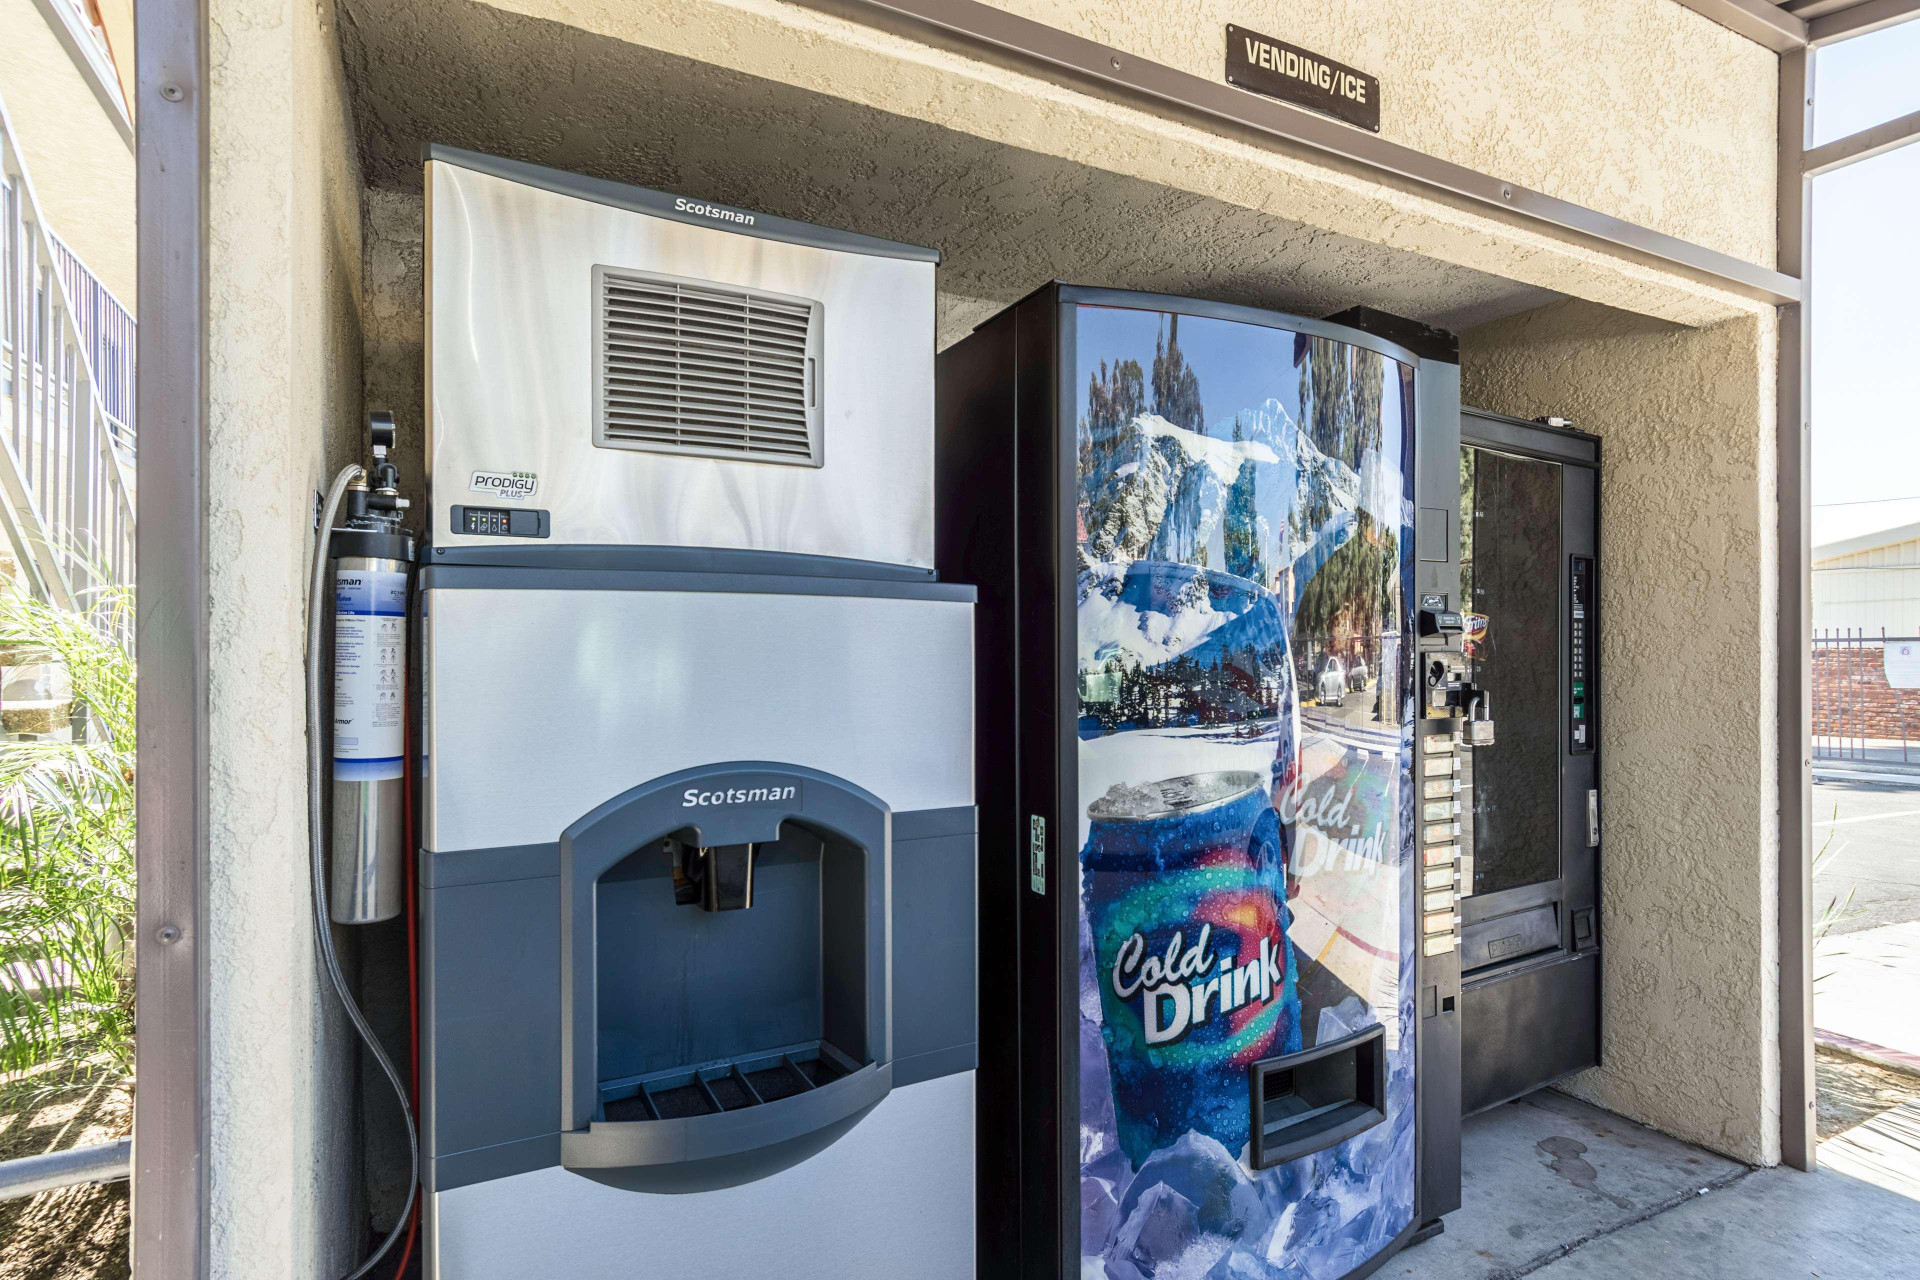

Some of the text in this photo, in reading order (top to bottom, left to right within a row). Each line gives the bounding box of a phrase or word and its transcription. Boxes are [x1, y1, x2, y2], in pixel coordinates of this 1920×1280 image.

[1245, 37, 1366, 104] VENDING/ICE
[674, 198, 755, 226] Scotsman
[500, 489, 523, 498] PLUS
[682, 786, 796, 807] Scotsman
[1279, 771, 1351, 828] Cold
[1287, 821, 1387, 877] Drink
[1112, 922, 1215, 998] Cold
[1143, 936, 1282, 1045] Drink
